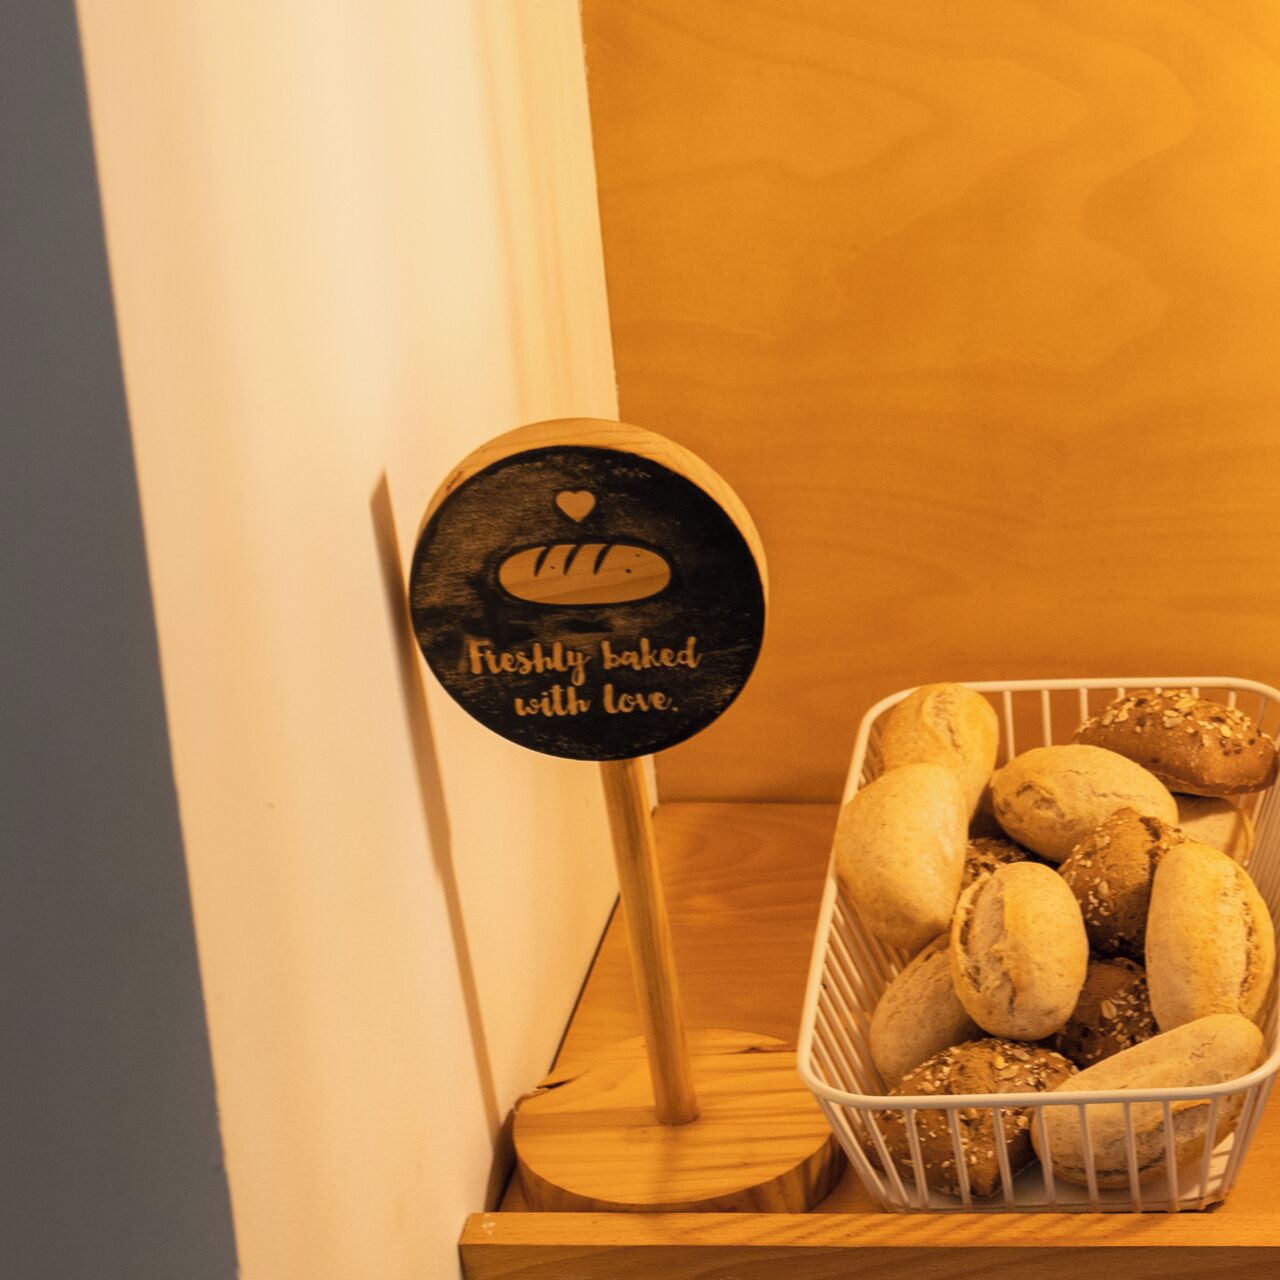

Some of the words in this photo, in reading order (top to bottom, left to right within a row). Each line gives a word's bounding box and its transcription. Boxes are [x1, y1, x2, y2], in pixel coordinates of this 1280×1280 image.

[467, 639, 591, 686] Freshly
[601, 637, 703, 672] baked
[514, 684, 592, 717] with
[603, 684, 680, 714] love.
